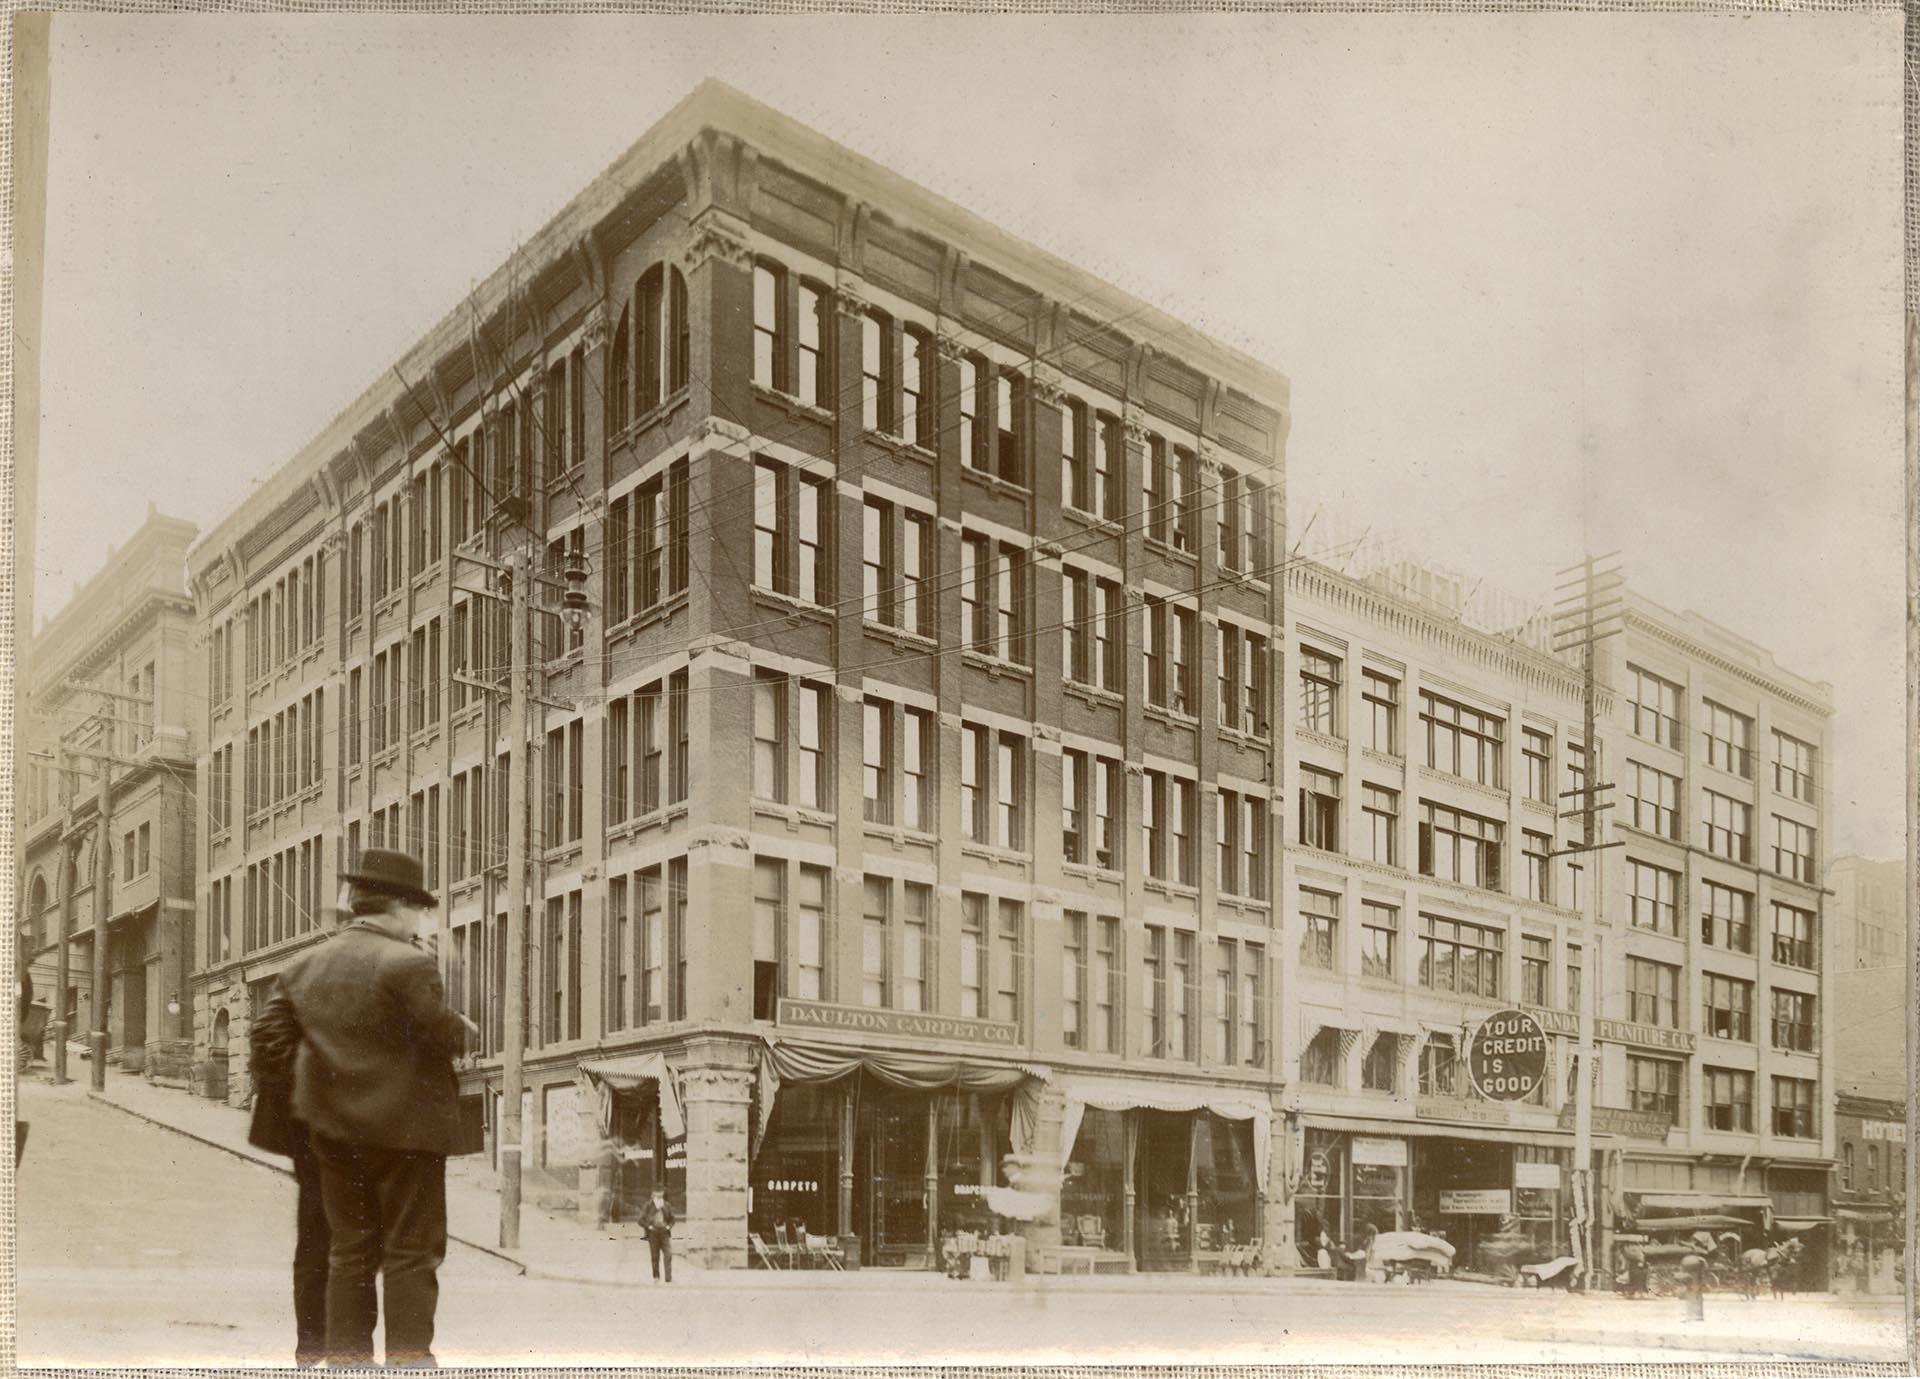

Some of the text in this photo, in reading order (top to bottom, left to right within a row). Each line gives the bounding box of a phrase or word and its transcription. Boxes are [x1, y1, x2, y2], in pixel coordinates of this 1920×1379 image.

[790, 1006, 1012, 1041] DAULTON CARPET CO.
[1484, 1018, 1533, 1036] YOUR
[1531, 1010, 1579, 1034] STANDA
[1600, 1022, 1667, 1047] FURNITURE
[1483, 1037, 1542, 1055] CREDIT
[1483, 1058, 1503, 1074] IS
[1483, 1076, 1532, 1093] GOOD
[767, 1179, 818, 1192] CARPETS
